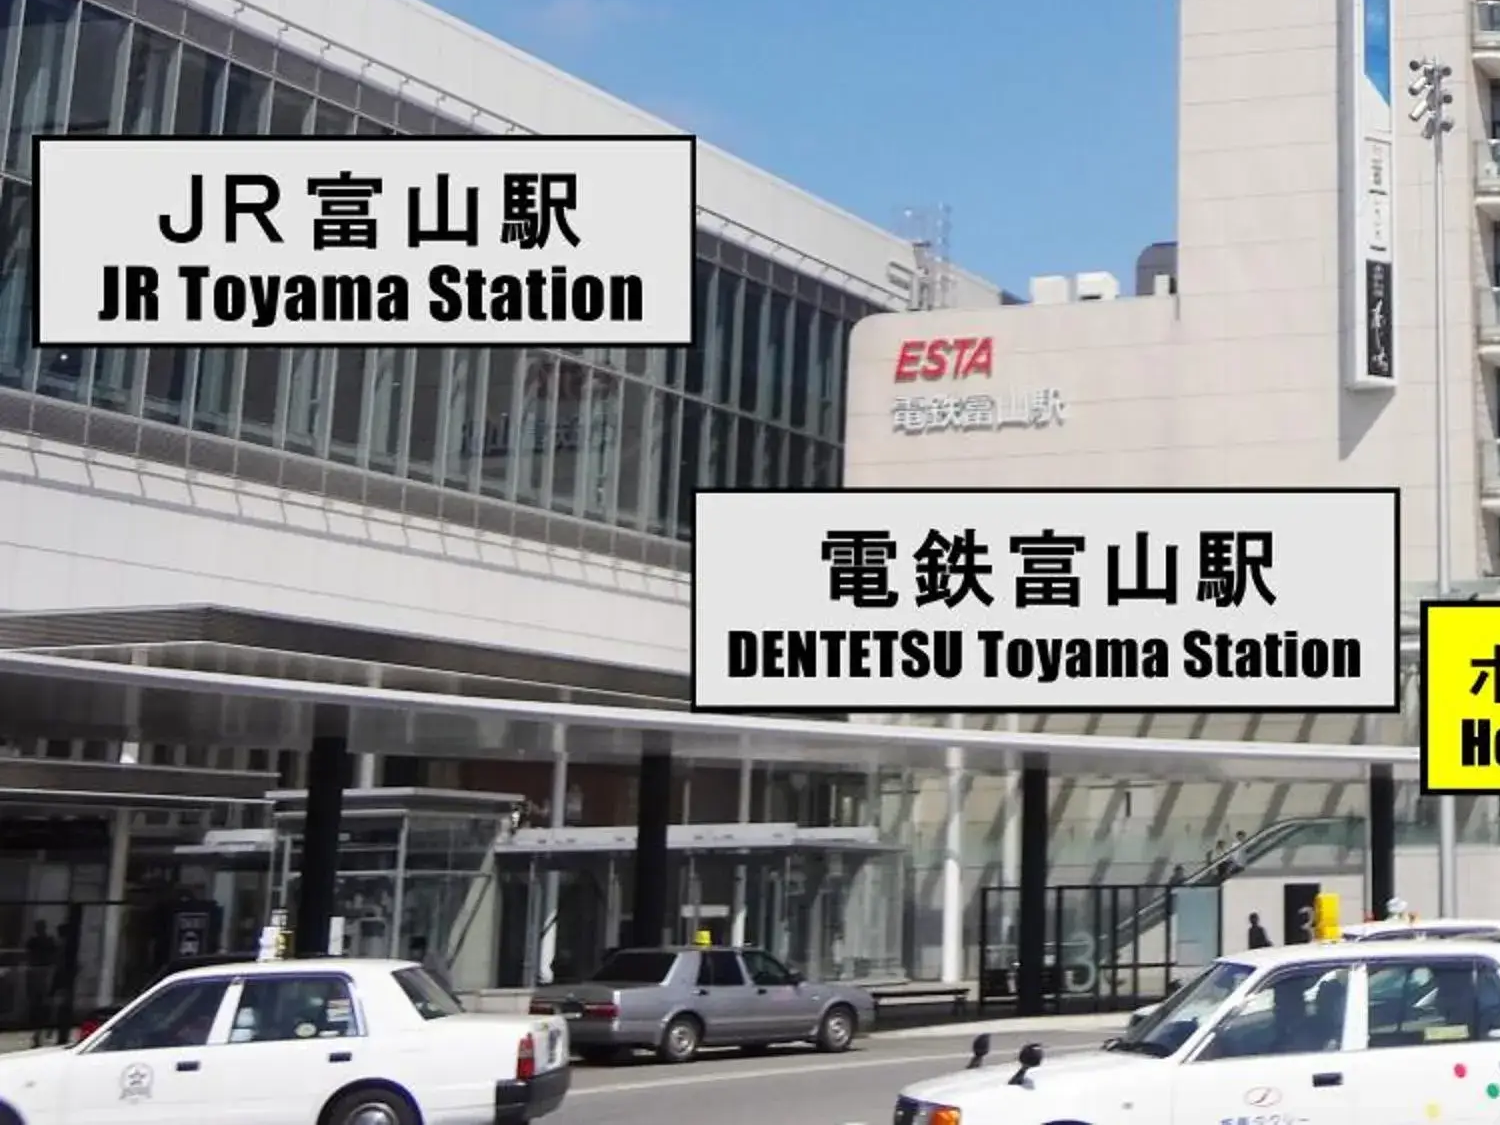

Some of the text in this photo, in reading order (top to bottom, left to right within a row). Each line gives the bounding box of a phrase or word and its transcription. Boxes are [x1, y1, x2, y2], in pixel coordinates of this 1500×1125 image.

[894, 337, 993, 383] ESTA
[892, 386, 1068, 434] 電鉄富山駅
